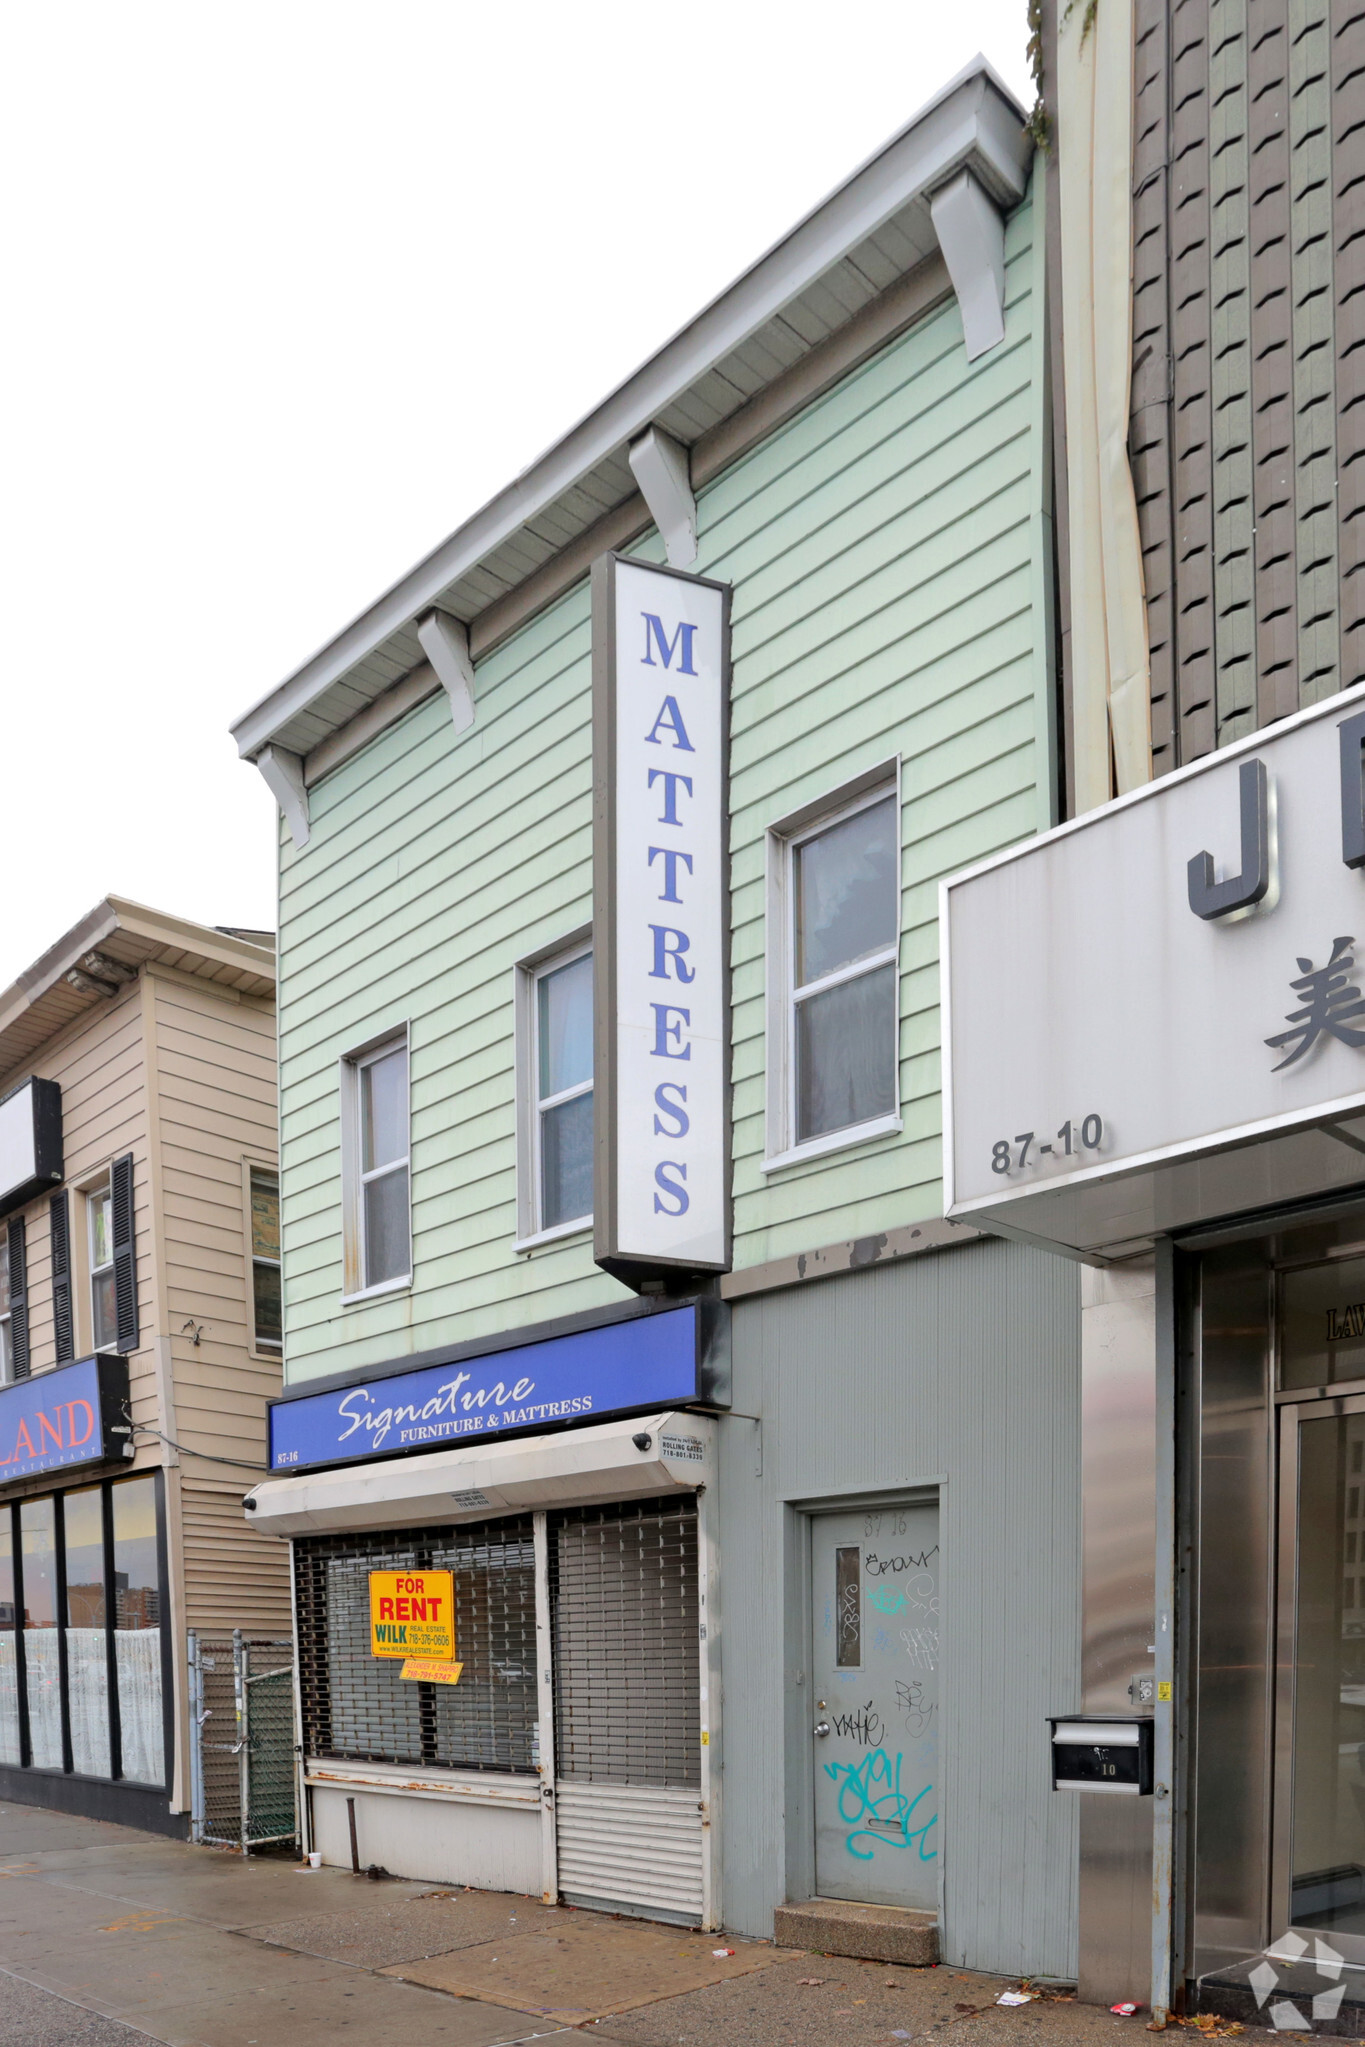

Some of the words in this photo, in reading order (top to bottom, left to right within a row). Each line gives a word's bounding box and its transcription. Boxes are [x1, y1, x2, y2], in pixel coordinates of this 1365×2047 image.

[640, 611, 699, 1217] MATTRESS
[991, 1113, 1103, 1175] 87-10
[338, 1371, 536, 1449] Signature
[400, 1416, 484, 1443] FURNITURE
[486, 1415, 500, 1427] &
[502, 1395, 593, 1425] MATTRESS
[277, 1450, 299, 1465] 87-16
[662, 1442, 685, 1450] ROLLING
[686, 1445, 703, 1453] GATES
[3, 1446, 97, 1475] RESTAURANT
[396, 1578, 424, 1594] FOR
[380, 1597, 442, 1622] RENT
[375, 1624, 407, 1644] WILK
[1102, 1763, 1116, 1776] 10
